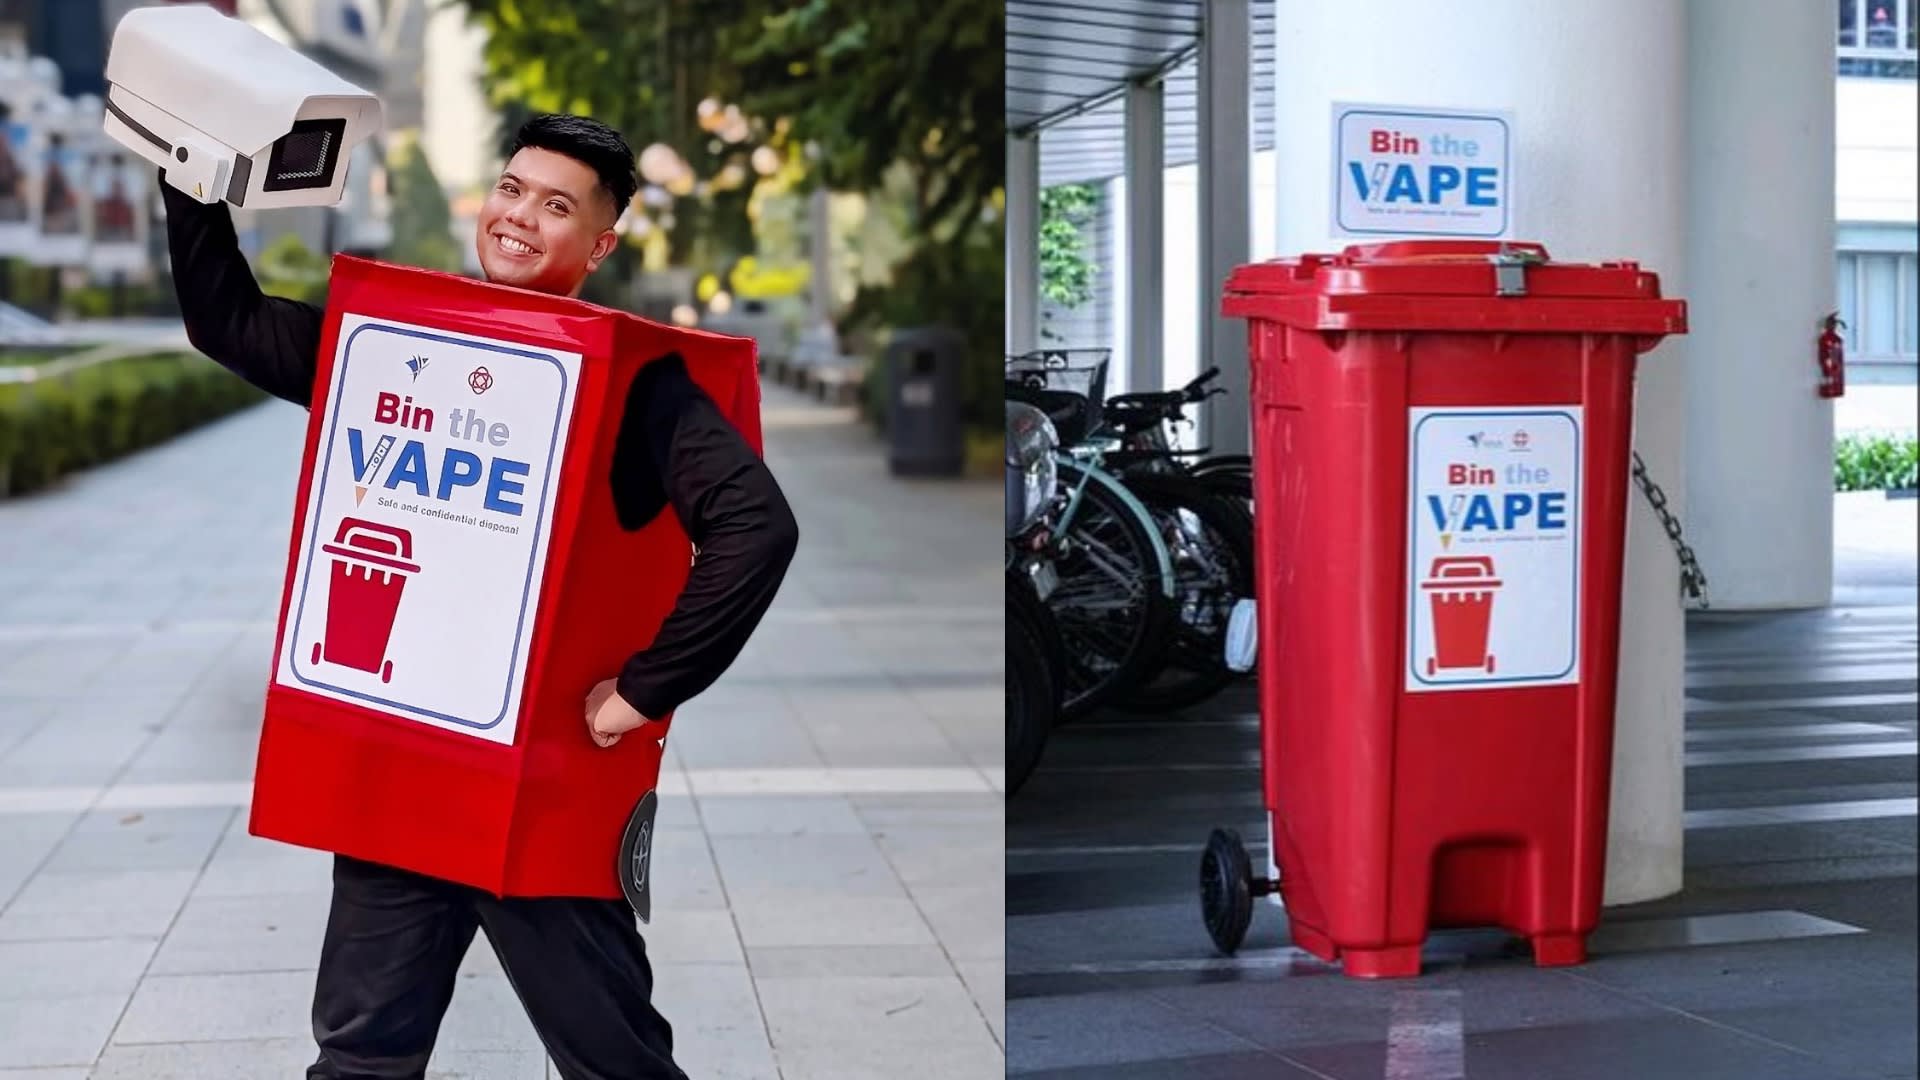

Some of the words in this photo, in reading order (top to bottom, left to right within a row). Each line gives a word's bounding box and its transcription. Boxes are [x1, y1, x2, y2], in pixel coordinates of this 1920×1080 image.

[1371, 131, 1419, 154] Bin
[1430, 133, 1479, 157] the
[1348, 161, 1499, 207] VAPE
[375, 392, 434, 432] Bin
[449, 408, 510, 447] the
[347, 427, 531, 517] VAPE
[1448, 464, 1495, 485] Bin
[1505, 463, 1550, 484] the
[377, 497, 399, 509] Safe
[400, 503, 419, 514] and
[421, 507, 477, 526] confidential
[479, 519, 520, 536] disposal
[1427, 492, 1567, 532] VAPE
